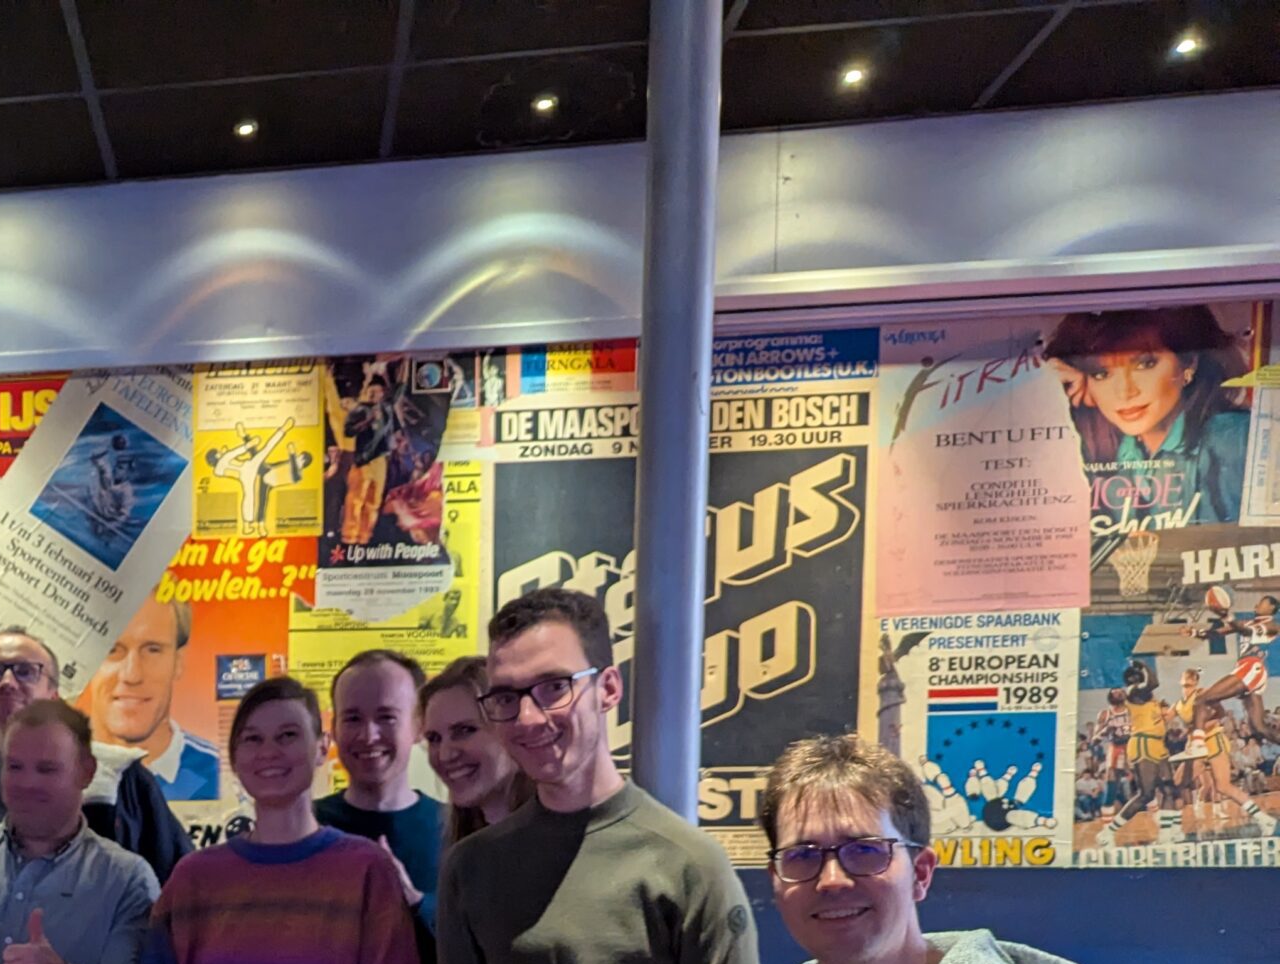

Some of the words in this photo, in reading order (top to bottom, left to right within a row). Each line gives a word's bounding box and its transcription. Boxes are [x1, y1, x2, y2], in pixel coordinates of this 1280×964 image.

[746, 348, 825, 364] ARROWS
[502, 411, 534, 441] DE
[538, 404, 639, 440] MAASPO
[712, 398, 766, 431] DEN
[772, 394, 858, 428] BOSCH
[749, 432, 797, 447] 19.30
[802, 430, 842, 445] UUR
[935, 430, 1002, 448] BENT
[1007, 429, 1024, 442] U
[1030, 426, 1070, 441] FIT
[520, 443, 593, 458] ZONDAG
[612, 442, 623, 455] 9
[246, 538, 288, 574] ga
[347, 545, 366, 563] Up
[366, 543, 392, 560] with
[394, 541, 440, 561] People
[6, 537, 91, 604] Sportcentrum
[35, 533, 45, 549] 3
[43, 540, 96, 584] februari
[93, 575, 125, 605] 1991
[392, 569, 444, 580] Maaspoort
[43, 581, 72, 609] Den
[72, 604, 111, 638] Bosch
[892, 614, 972, 631] VERENIGDE
[976, 612, 1061, 628] SPAARBANK
[928, 633, 1028, 650] PRESENTEERT
[948, 653, 1060, 672] EUROPEAN
[928, 671, 1058, 686] CHAMPIONSHIPS
[1003, 686, 1058, 705] 1989
[933, 836, 1057, 866] WLING
